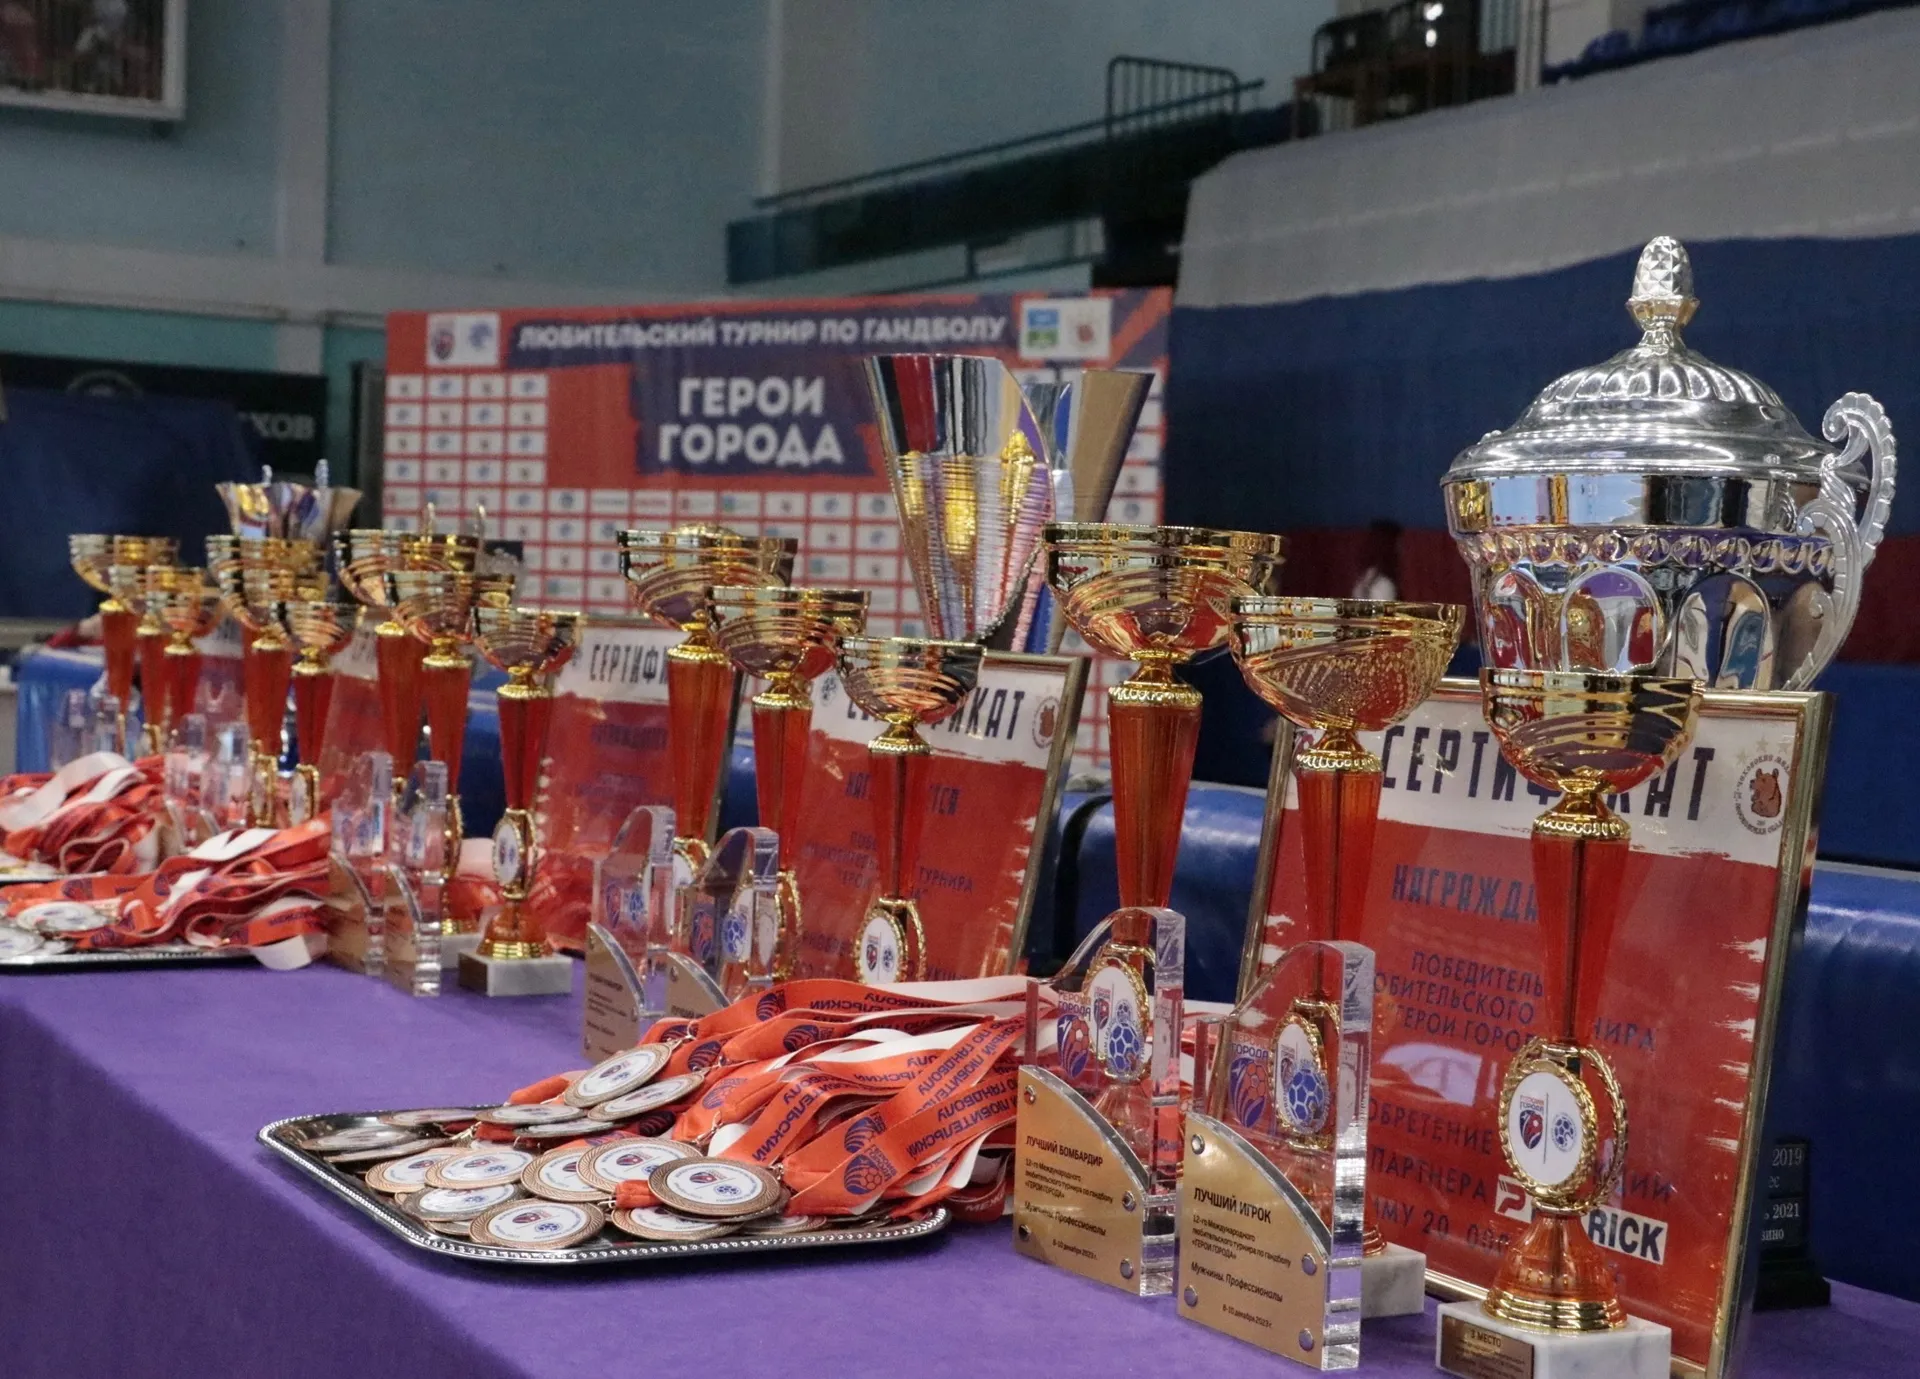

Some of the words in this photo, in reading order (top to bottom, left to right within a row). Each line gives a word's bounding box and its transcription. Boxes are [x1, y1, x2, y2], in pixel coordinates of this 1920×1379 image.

[518, 316, 716, 350] ЛЮБИТЕЛЬСКИЙ
[719, 319, 816, 347] ТУРНИР
[820, 318, 861, 345] ПО
[863, 316, 1006, 345] ГАНДБОЛУ
[678, 375, 826, 418] ГЕРОИ
[657, 422, 846, 468] ГОРОДА
[1411, 951, 1544, 997] ПОБЕДИТЕЛЬ
[907, 1097, 1010, 1158] ЛЮБИТЕЛЬСКИЙ
[1025, 1135, 1058, 1154] ЛУЧШИЙ
[1059, 1144, 1104, 1167] БОМБАРДИР
[1371, 1147, 1487, 1203] ПАРТНЕРА
[1193, 1187, 1237, 1213] ЛУЧШИЙ
[1239, 1200, 1272, 1225] ИГРОК
[1192, 1227, 1233, 1247] любительского
[1233, 1241, 1256, 1255] турнира
[1264, 1251, 1291, 1269] гандболу
[1193, 1214, 1208, 1226] 12-го
[1208, 1219, 1256, 1242] Международного
[1225, 1273, 1284, 1303] Профессионалы
